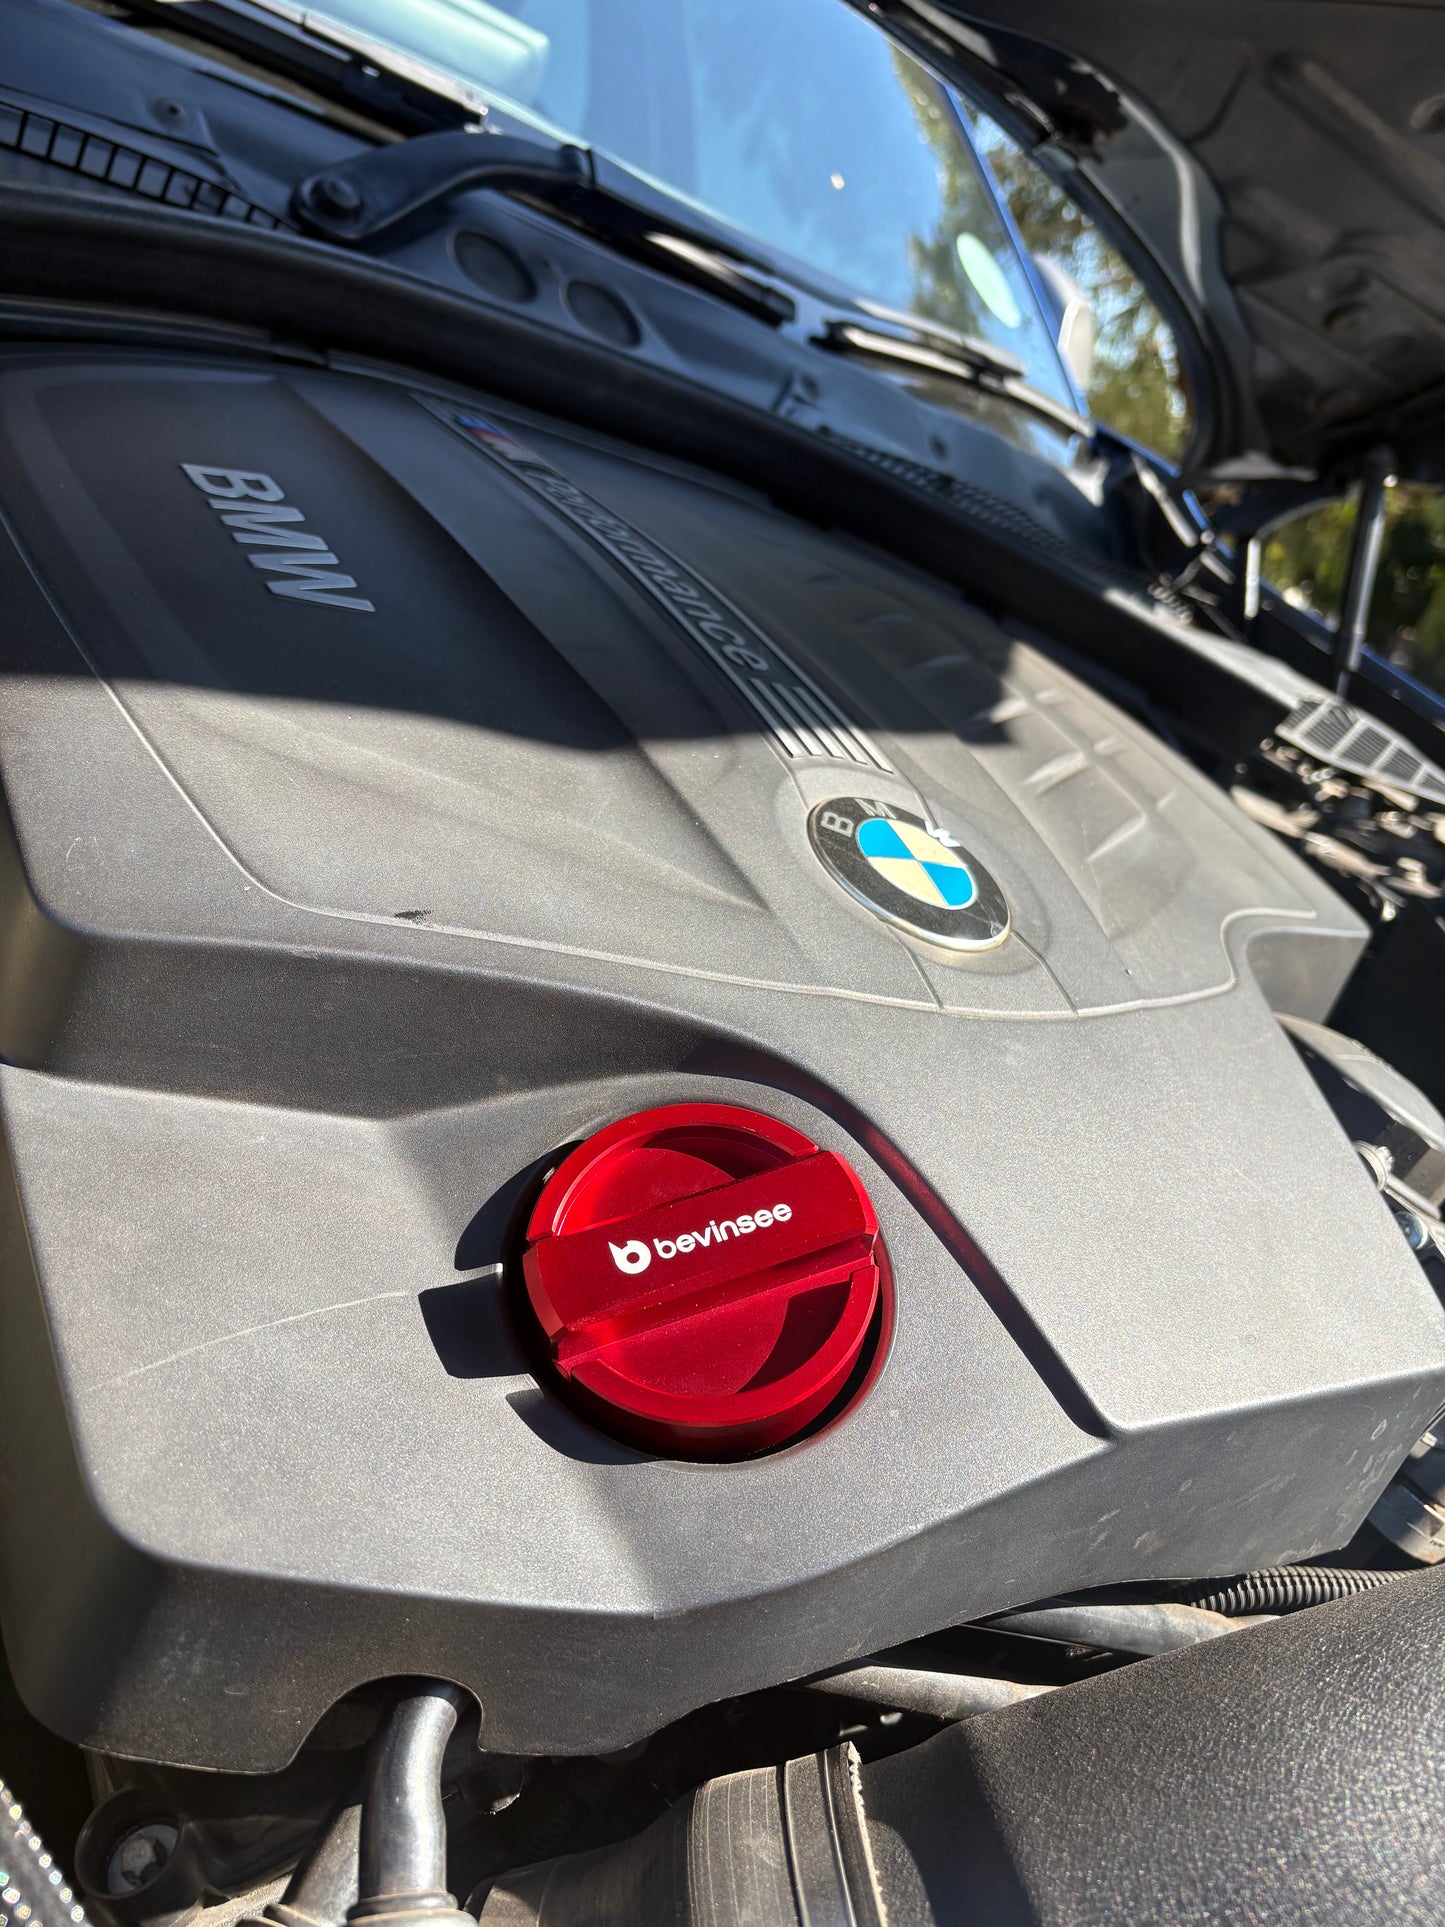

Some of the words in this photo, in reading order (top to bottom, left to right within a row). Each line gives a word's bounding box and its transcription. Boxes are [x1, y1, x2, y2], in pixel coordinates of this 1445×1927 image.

[180, 463, 376, 613] BMW
[519, 467, 770, 672] Performance
[652, 1203, 793, 1260] bevinsee
